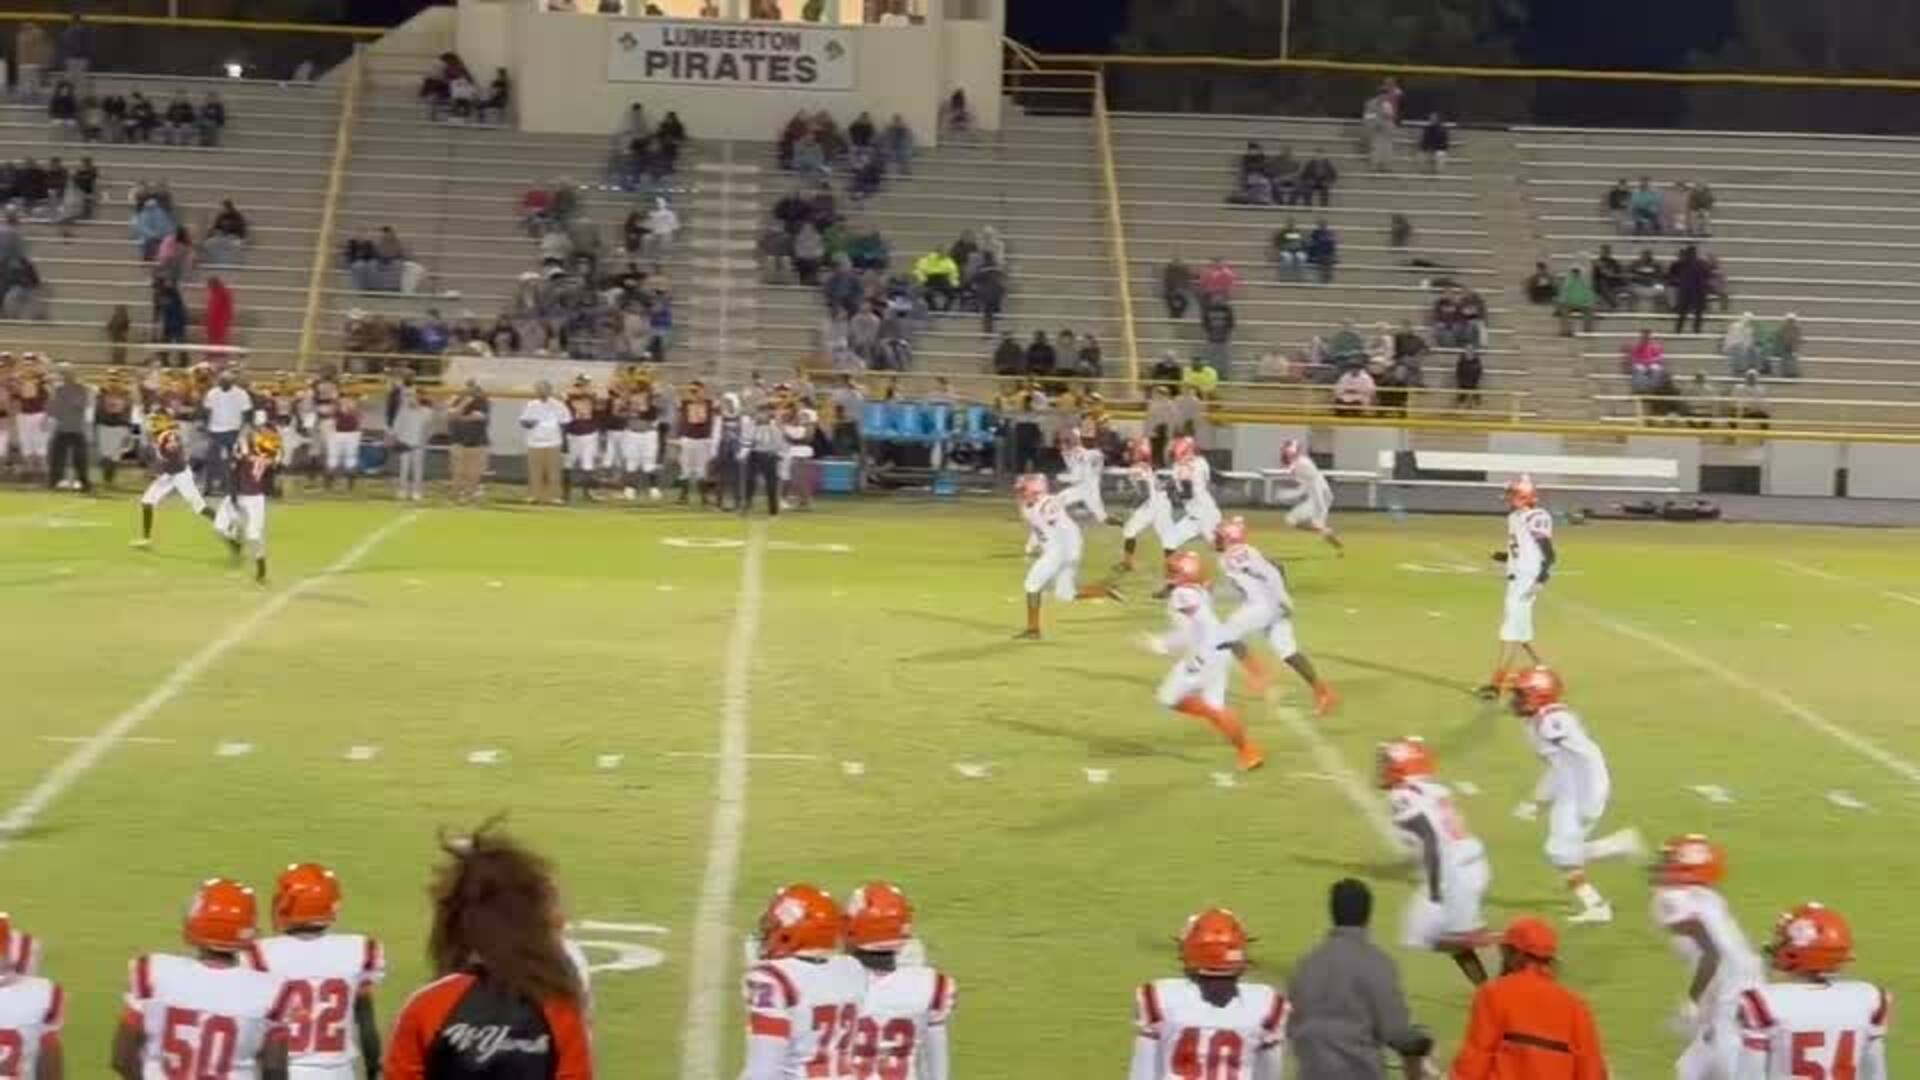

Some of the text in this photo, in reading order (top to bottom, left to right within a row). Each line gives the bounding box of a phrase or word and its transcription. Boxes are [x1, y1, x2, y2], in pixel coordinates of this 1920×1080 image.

[662, 27, 801, 50] LUMBERTON
[645, 50, 818, 83] PIRATES
[163, 1007, 238, 1080] 50
[1172, 1027, 1243, 1080] 40
[1792, 1030, 1856, 1080] 54
